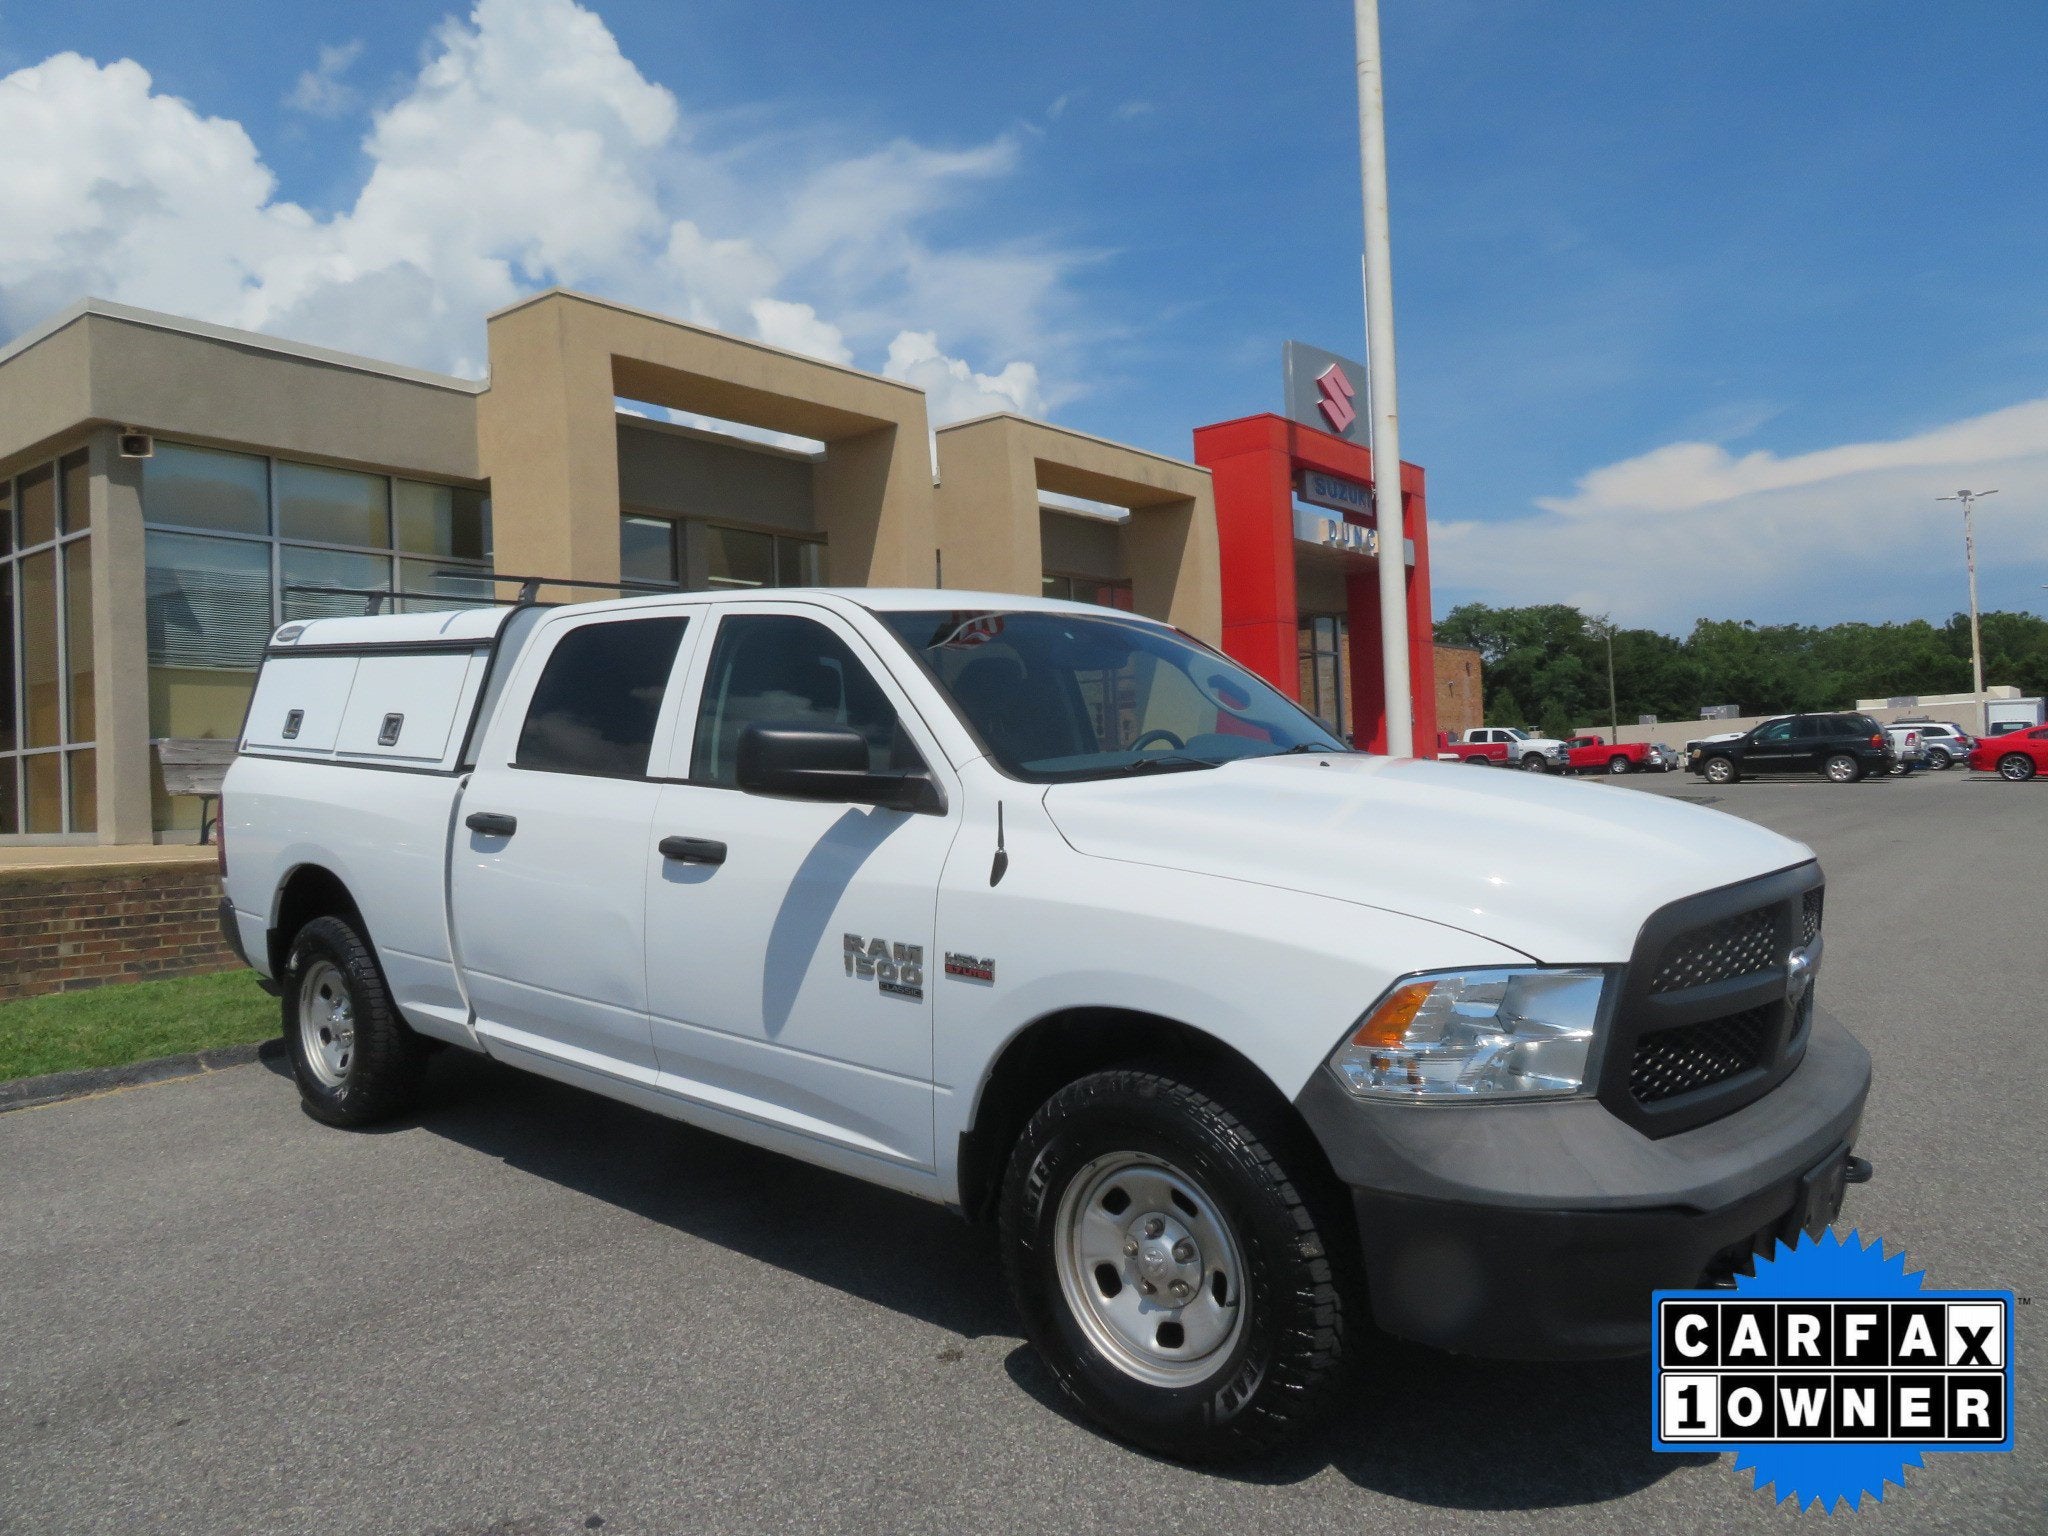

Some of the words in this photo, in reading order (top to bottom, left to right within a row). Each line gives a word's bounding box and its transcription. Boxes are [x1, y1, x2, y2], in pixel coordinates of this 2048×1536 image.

[1315, 477, 1372, 508] SUZUKI
[1328, 519, 1376, 549] DUNC
[843, 933, 923, 966] RAM
[844, 951, 923, 986] 1500
[879, 982, 923, 998] CLASSIC
